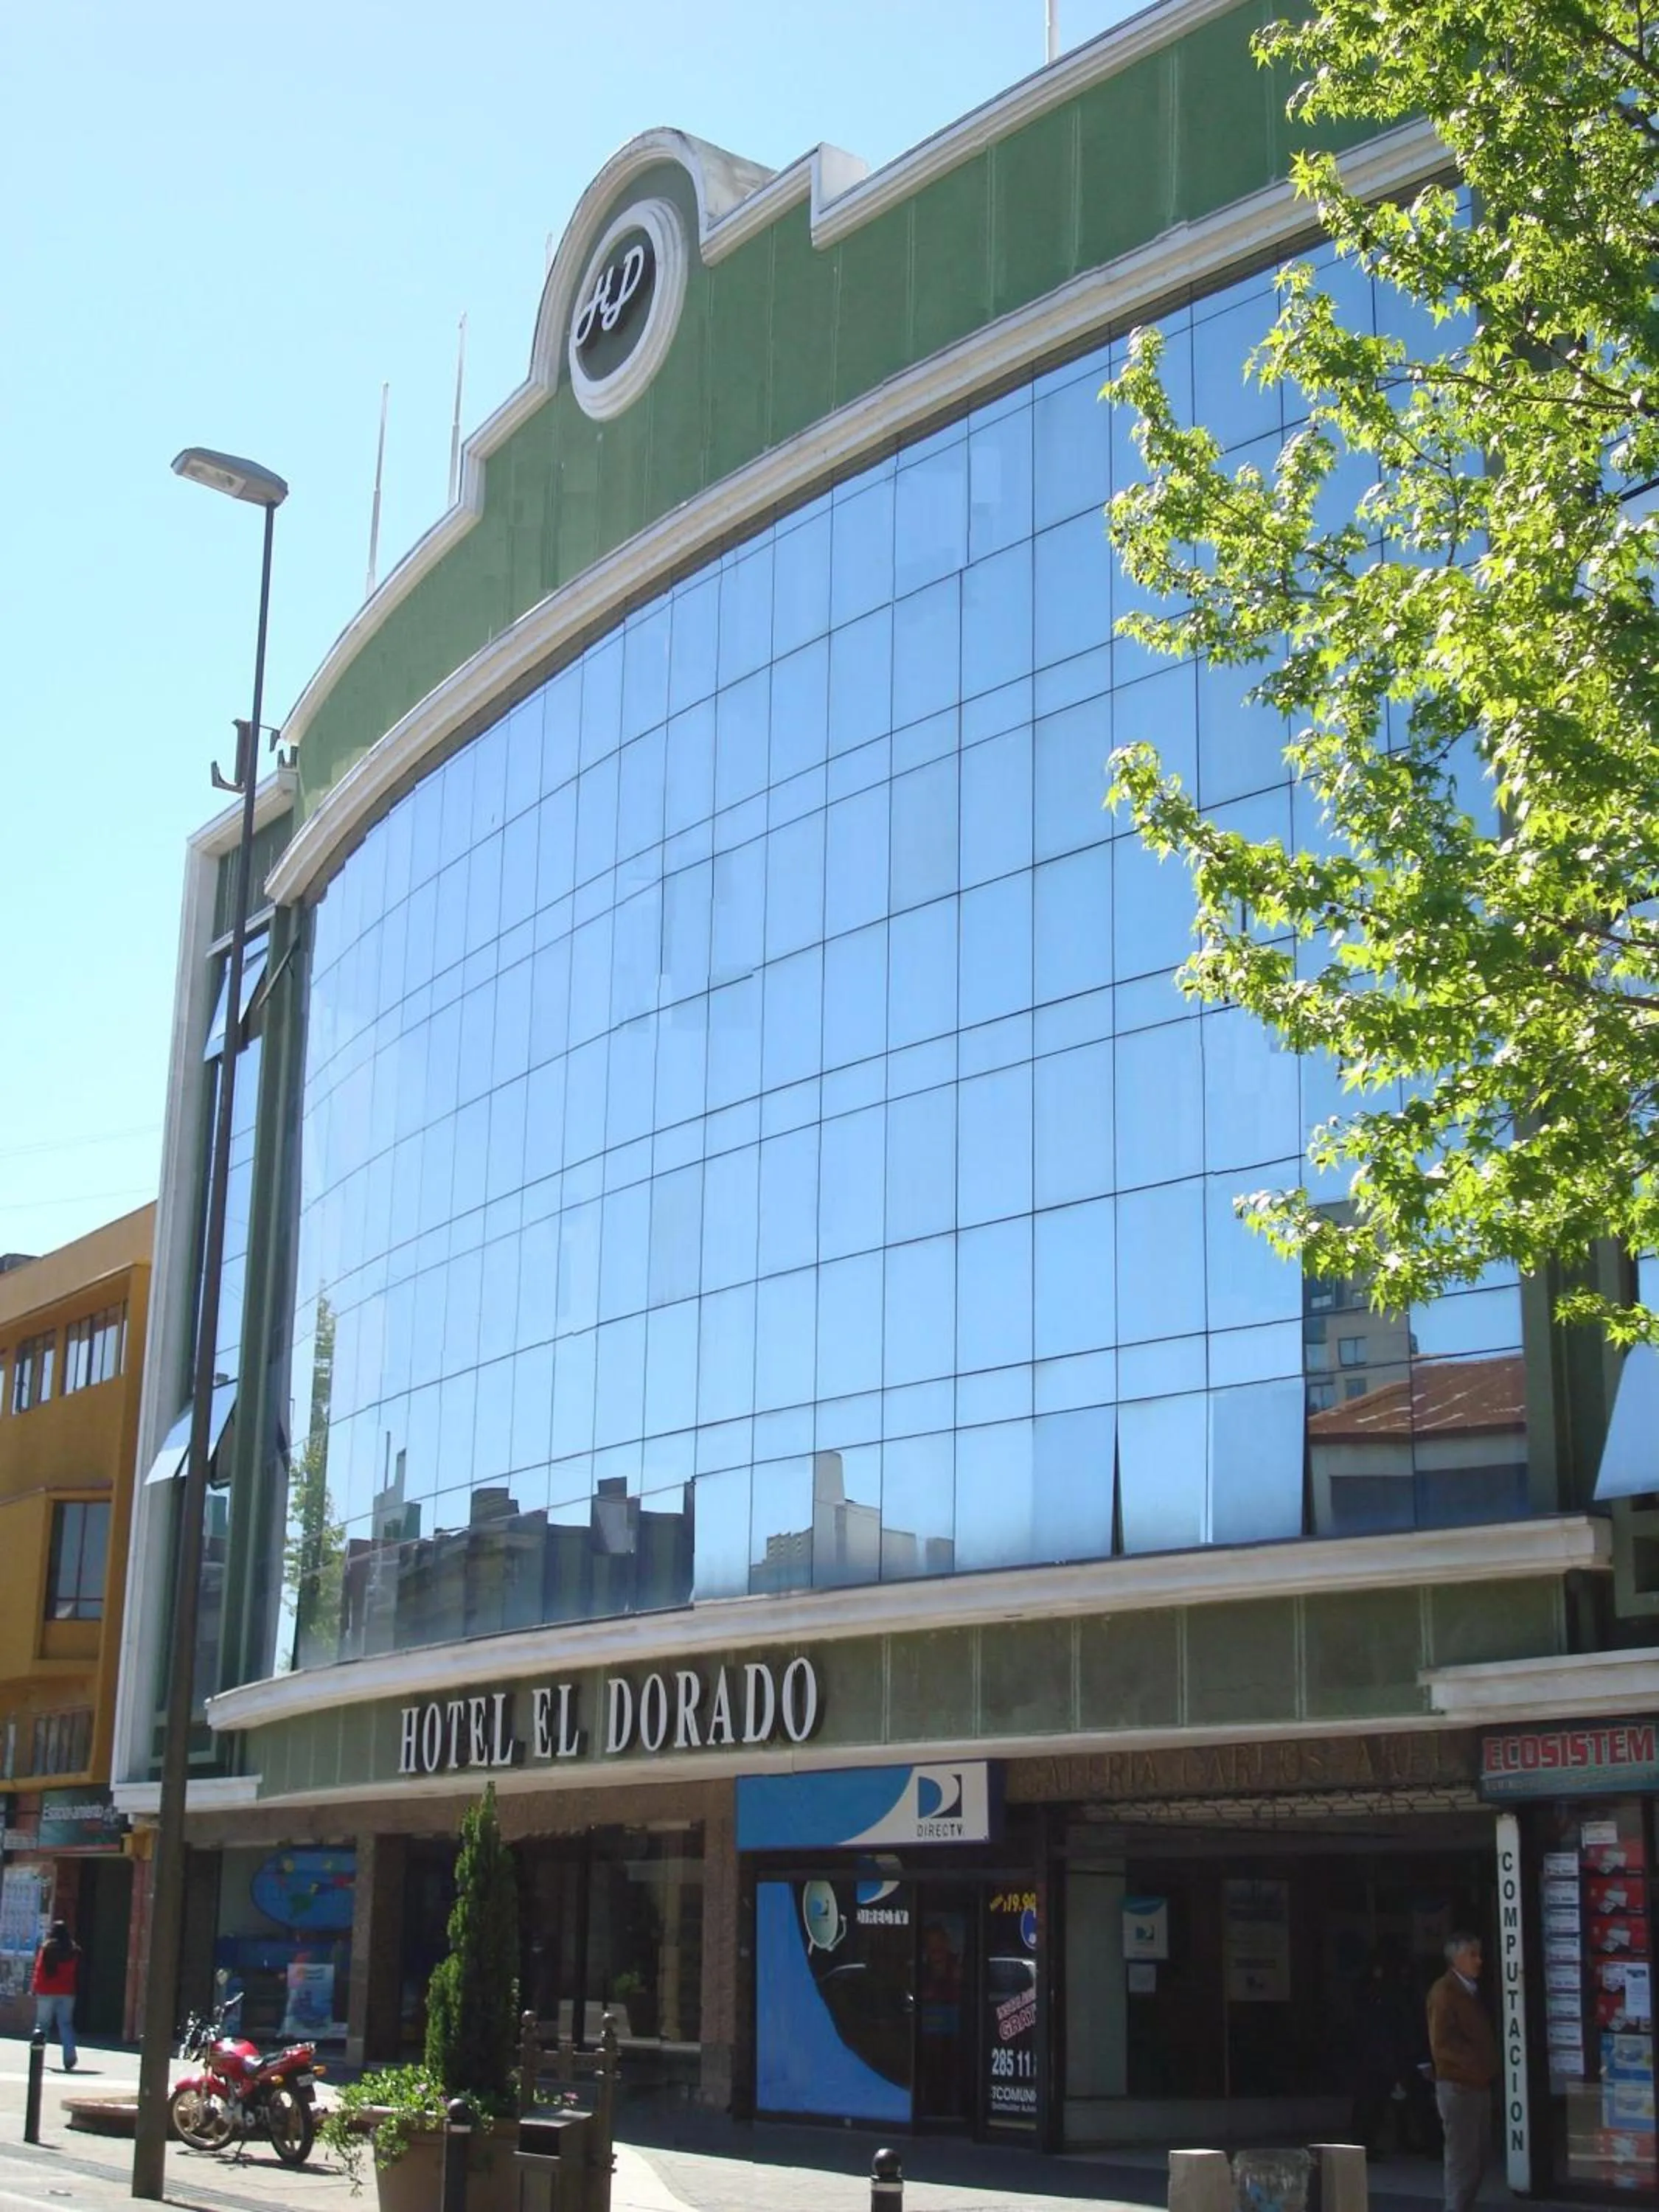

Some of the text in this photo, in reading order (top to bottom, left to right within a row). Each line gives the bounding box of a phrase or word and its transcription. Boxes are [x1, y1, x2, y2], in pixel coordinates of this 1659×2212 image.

[399, 1657, 817, 1773] HOTEL EL DORADO
[1482, 1725, 1656, 1773] ECOSISTEM
[917, 1823, 963, 1838] DIRECTV
[1502, 1851, 1524, 2152] COMPUTACION
[992, 2048, 1015, 2077] 285
